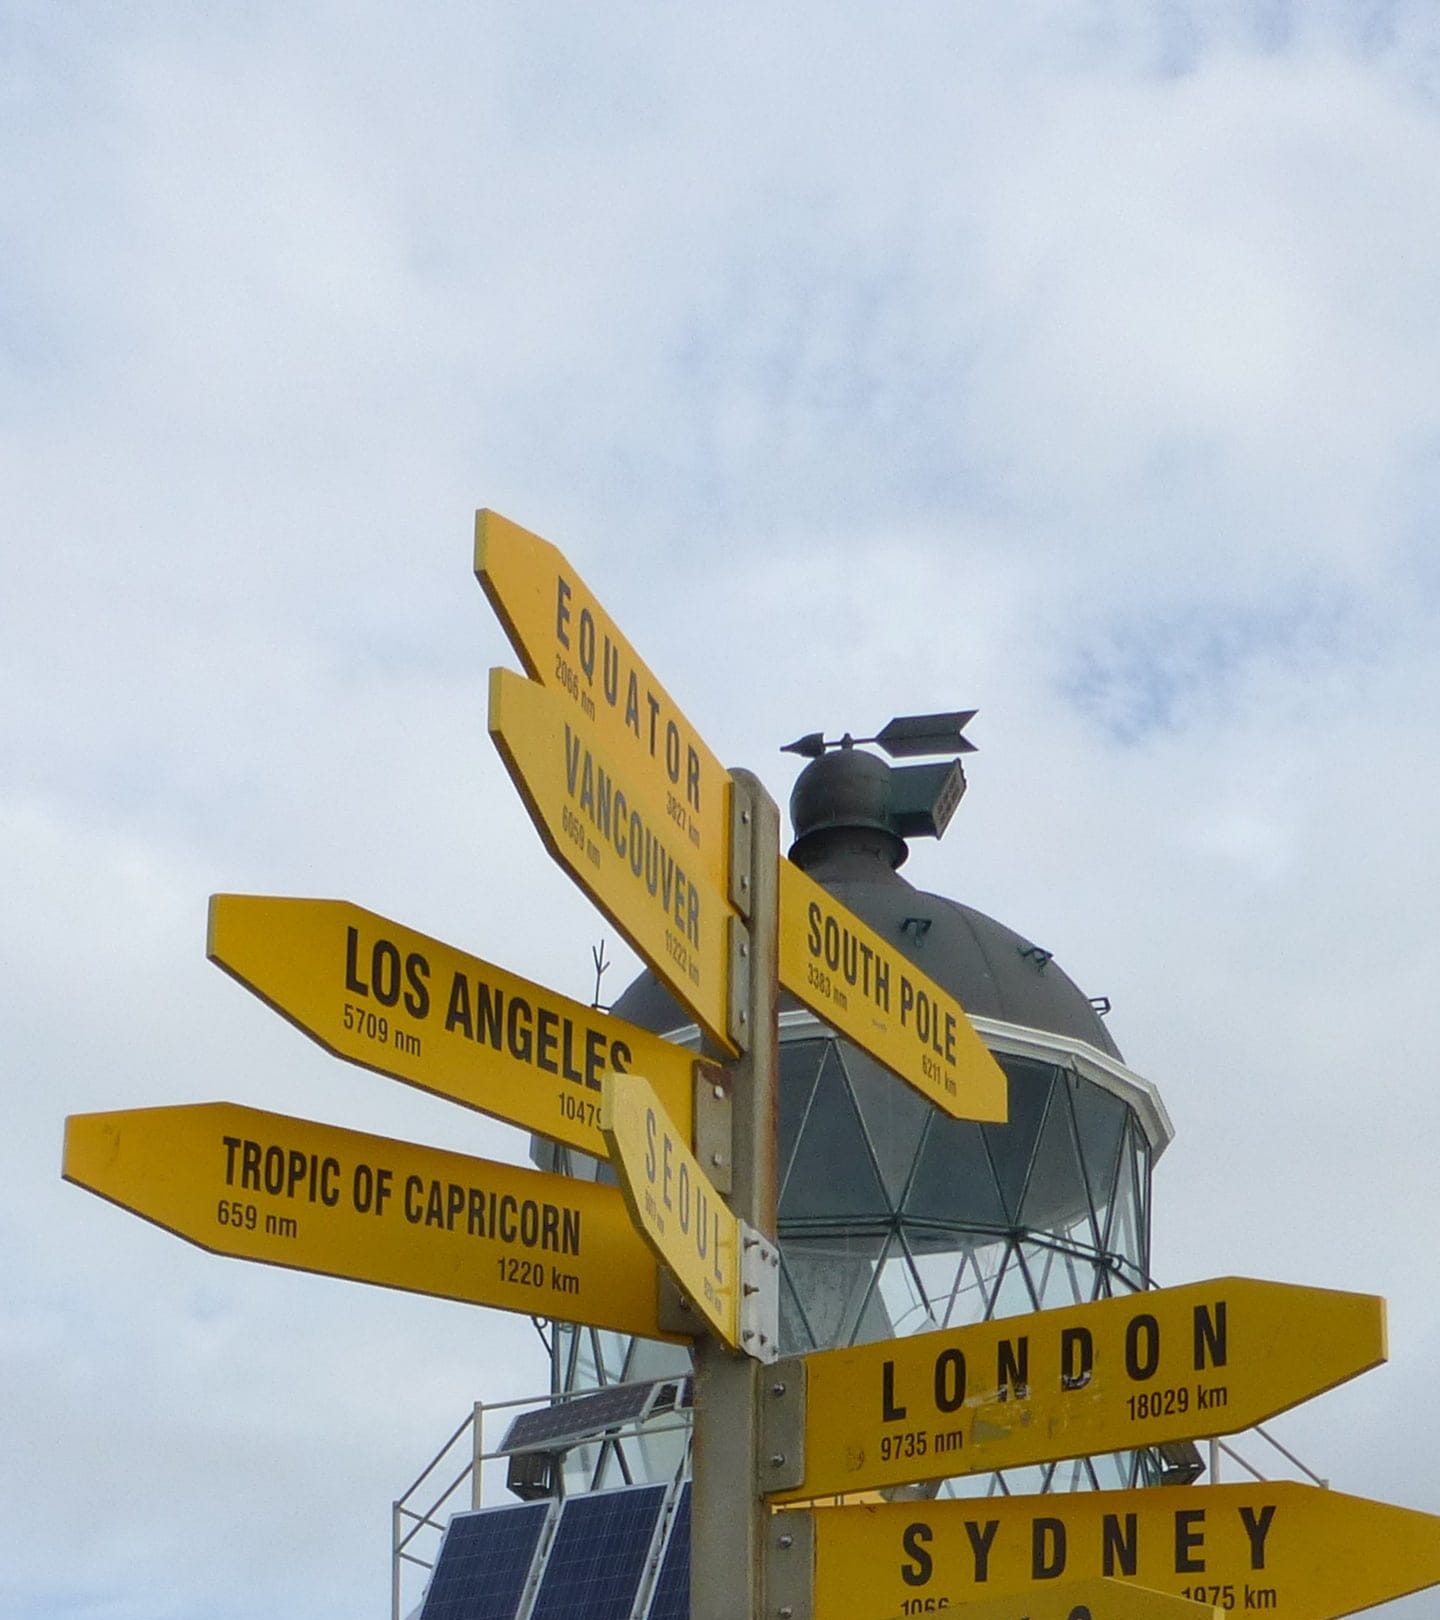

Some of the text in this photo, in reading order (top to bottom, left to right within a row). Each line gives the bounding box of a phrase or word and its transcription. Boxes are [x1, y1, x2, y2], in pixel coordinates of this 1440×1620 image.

[555, 653, 595, 722] 2066 nm
[557, 576, 700, 813] EQUATOR
[565, 722, 700, 951] VANCOUVER
[666, 790, 700, 849] 3827 km
[345, 926, 431, 1019] LOS
[688, 951, 700, 987] km
[808, 902, 957, 1067] SOUTH POLE
[808, 963, 847, 1012] 3383 nm
[343, 1004, 421, 1057] 5709 nm
[922, 1054, 956, 1097] 6211 km
[217, 1200, 298, 1239] 659 nm
[222, 1136, 341, 1207] TROPIC
[353, 1164, 393, 1216] OF
[404, 1175, 581, 1256] CAPRICORN
[645, 1107, 723, 1283] SEOUL
[497, 1256, 580, 1294] 1220 km
[882, 1301, 1227, 1423] LONDON
[1126, 1385, 1228, 1421] 18029 km
[881, 1430, 963, 1462] 9735 nm
[901, 1505, 1277, 1587] SYDNEY
[1244, 1584, 1277, 1609] km
